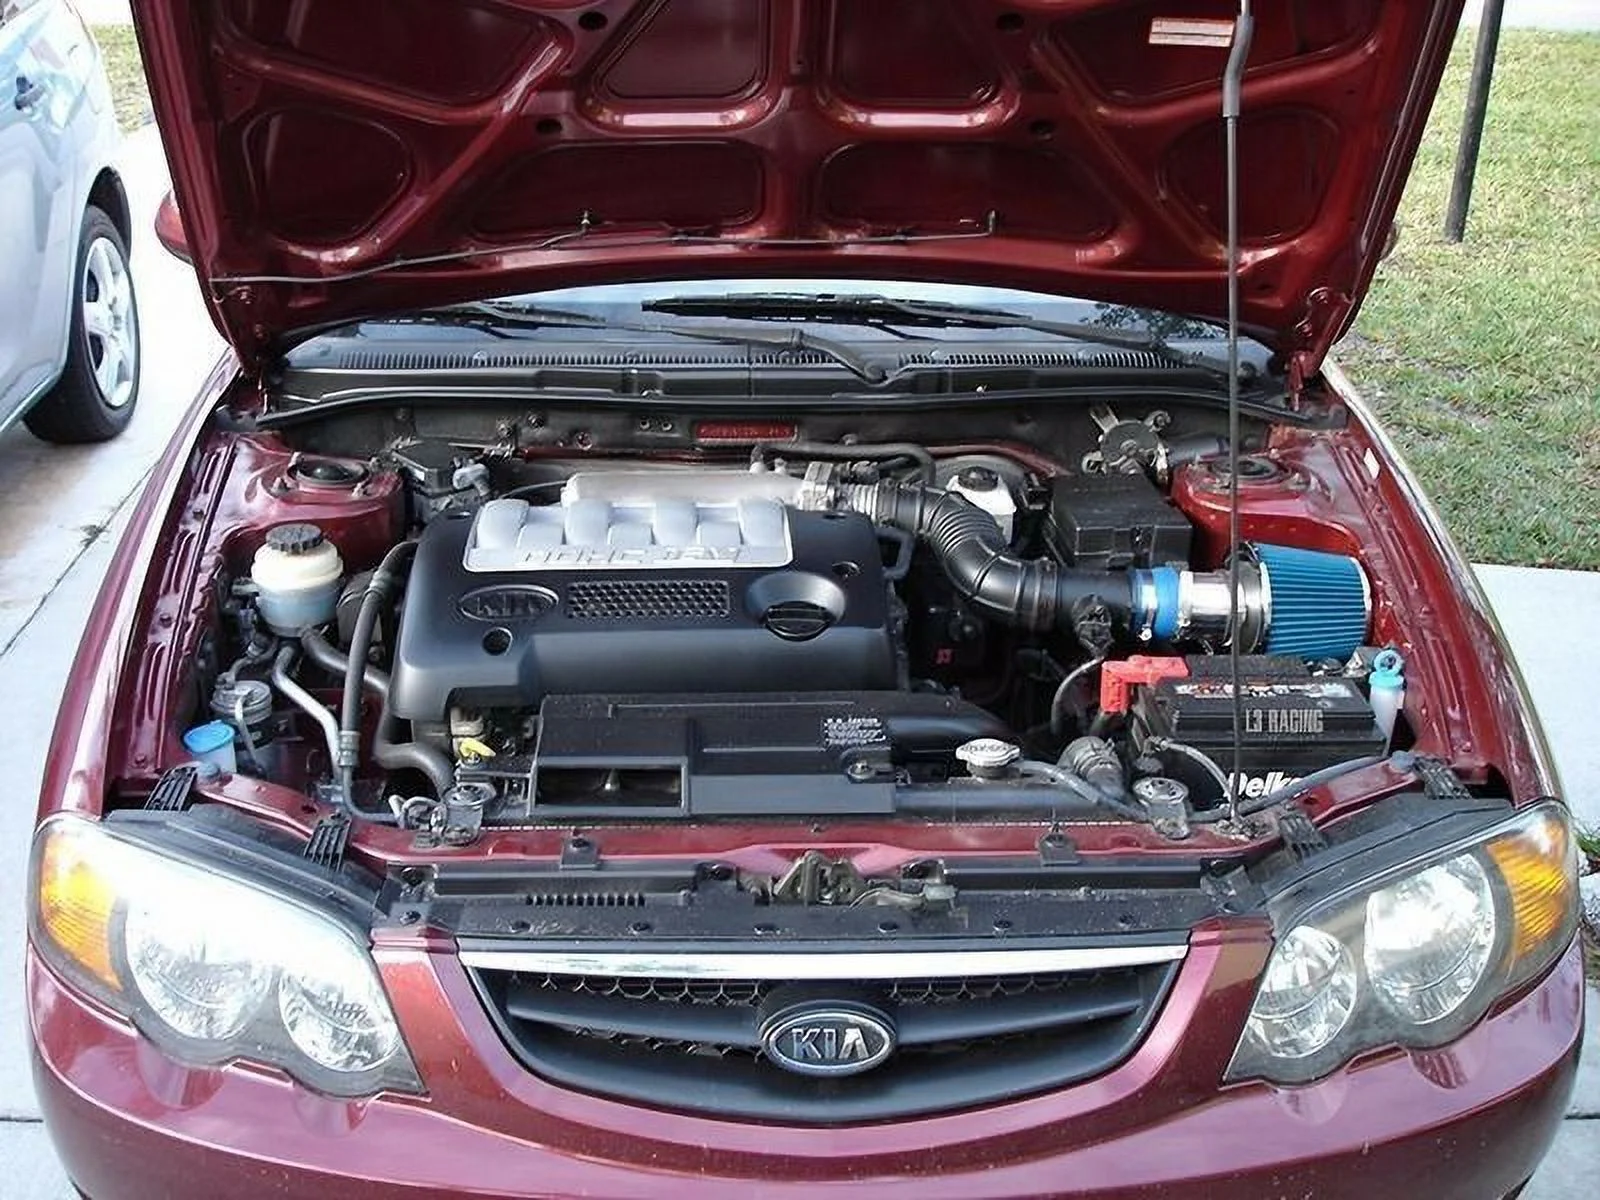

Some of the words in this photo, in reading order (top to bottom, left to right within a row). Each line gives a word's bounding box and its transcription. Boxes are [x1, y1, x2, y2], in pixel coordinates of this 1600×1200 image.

[1268, 709, 1323, 733] RACING
[1227, 772, 1303, 798] Delk
[791, 1027, 869, 1059] KIA
